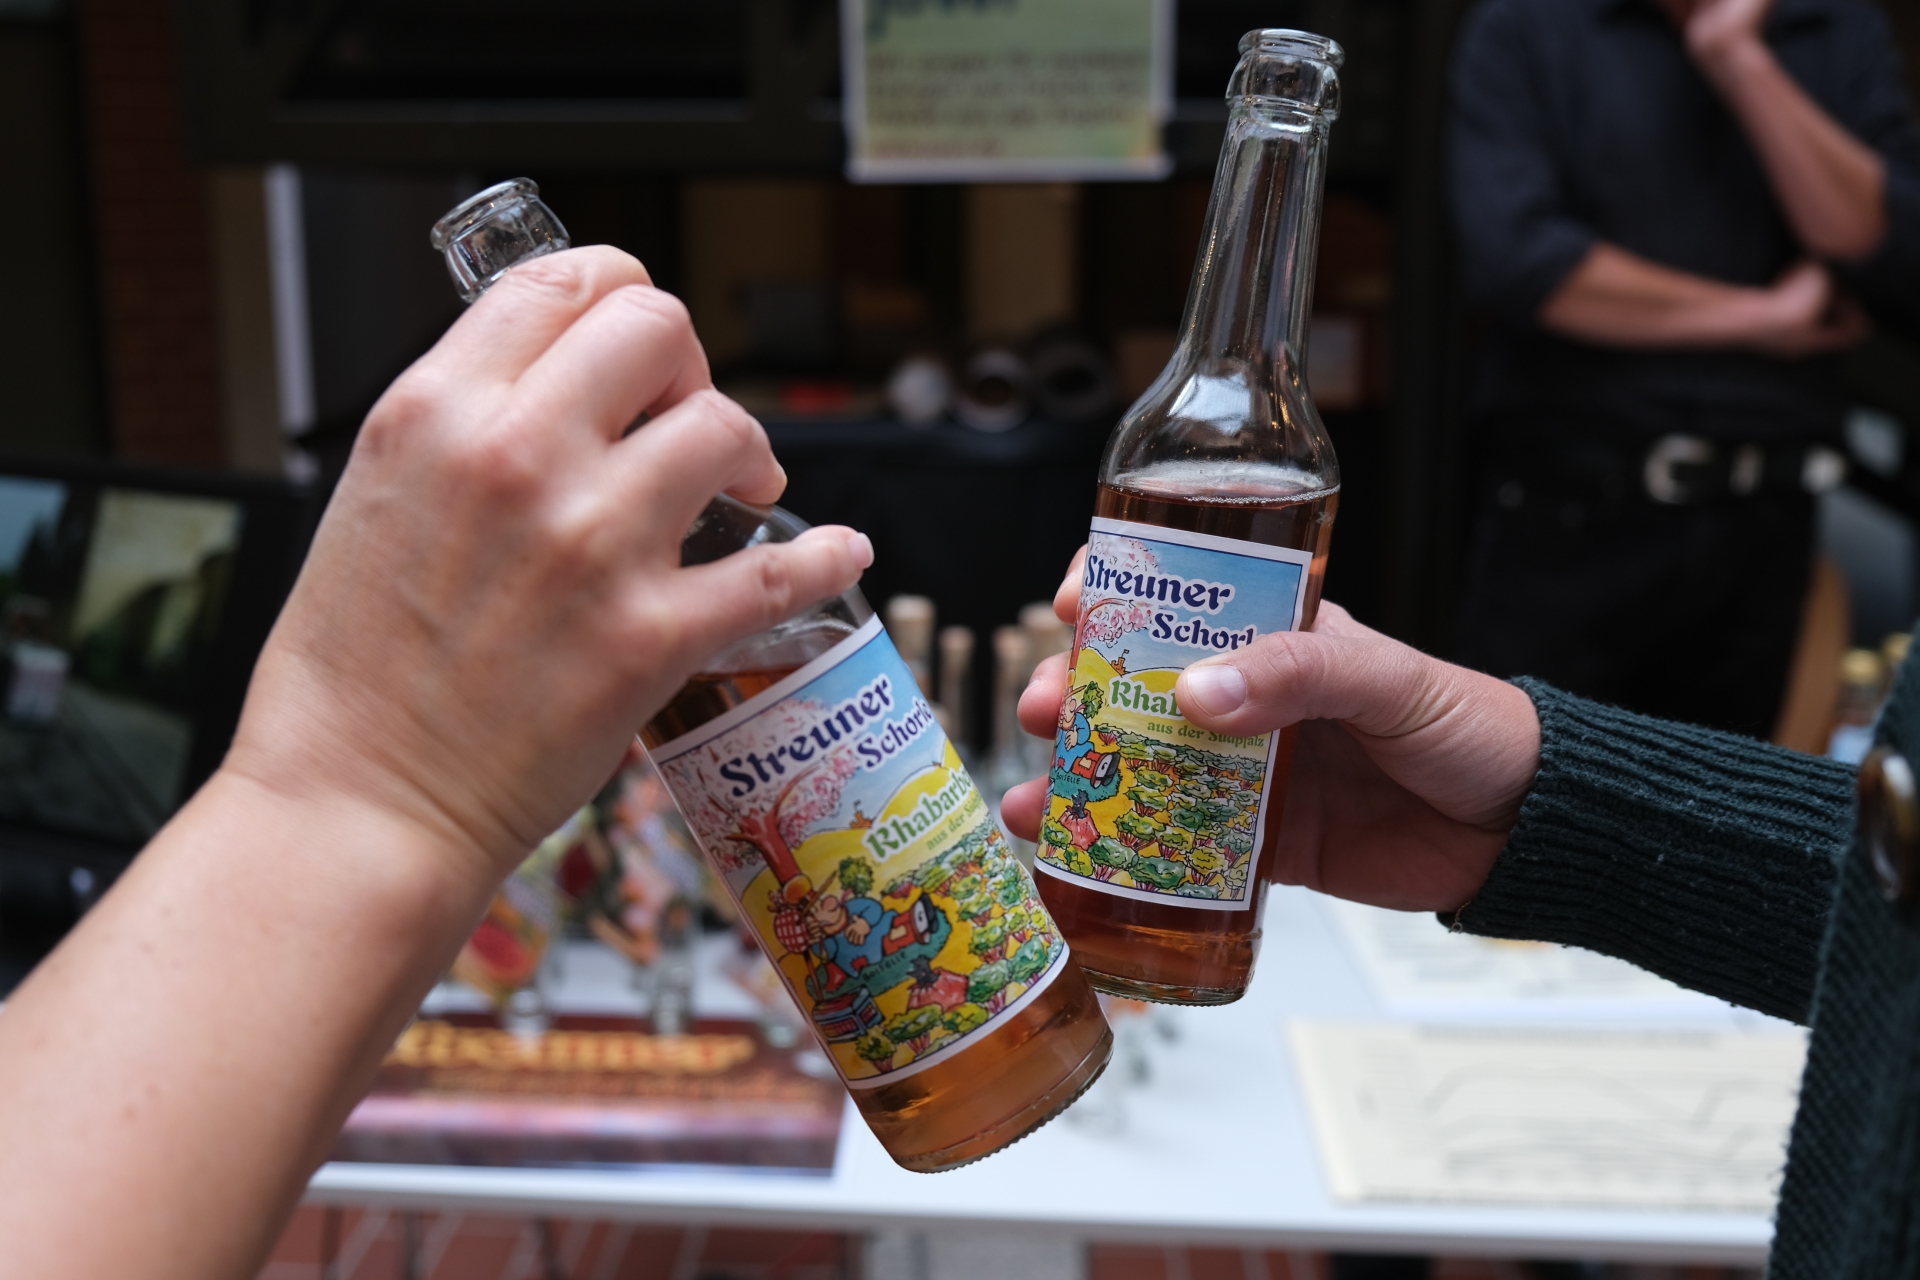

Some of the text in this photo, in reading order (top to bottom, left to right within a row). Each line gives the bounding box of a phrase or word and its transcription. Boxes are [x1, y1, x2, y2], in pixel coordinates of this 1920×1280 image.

[1085, 555, 1231, 610] Streuner
[1152, 613, 1254, 650] Schorl
[719, 679, 890, 797] Streuner
[1147, 722, 1173, 735] aus
[1178, 725, 1204, 739] der
[926, 830, 949, 851] aus
